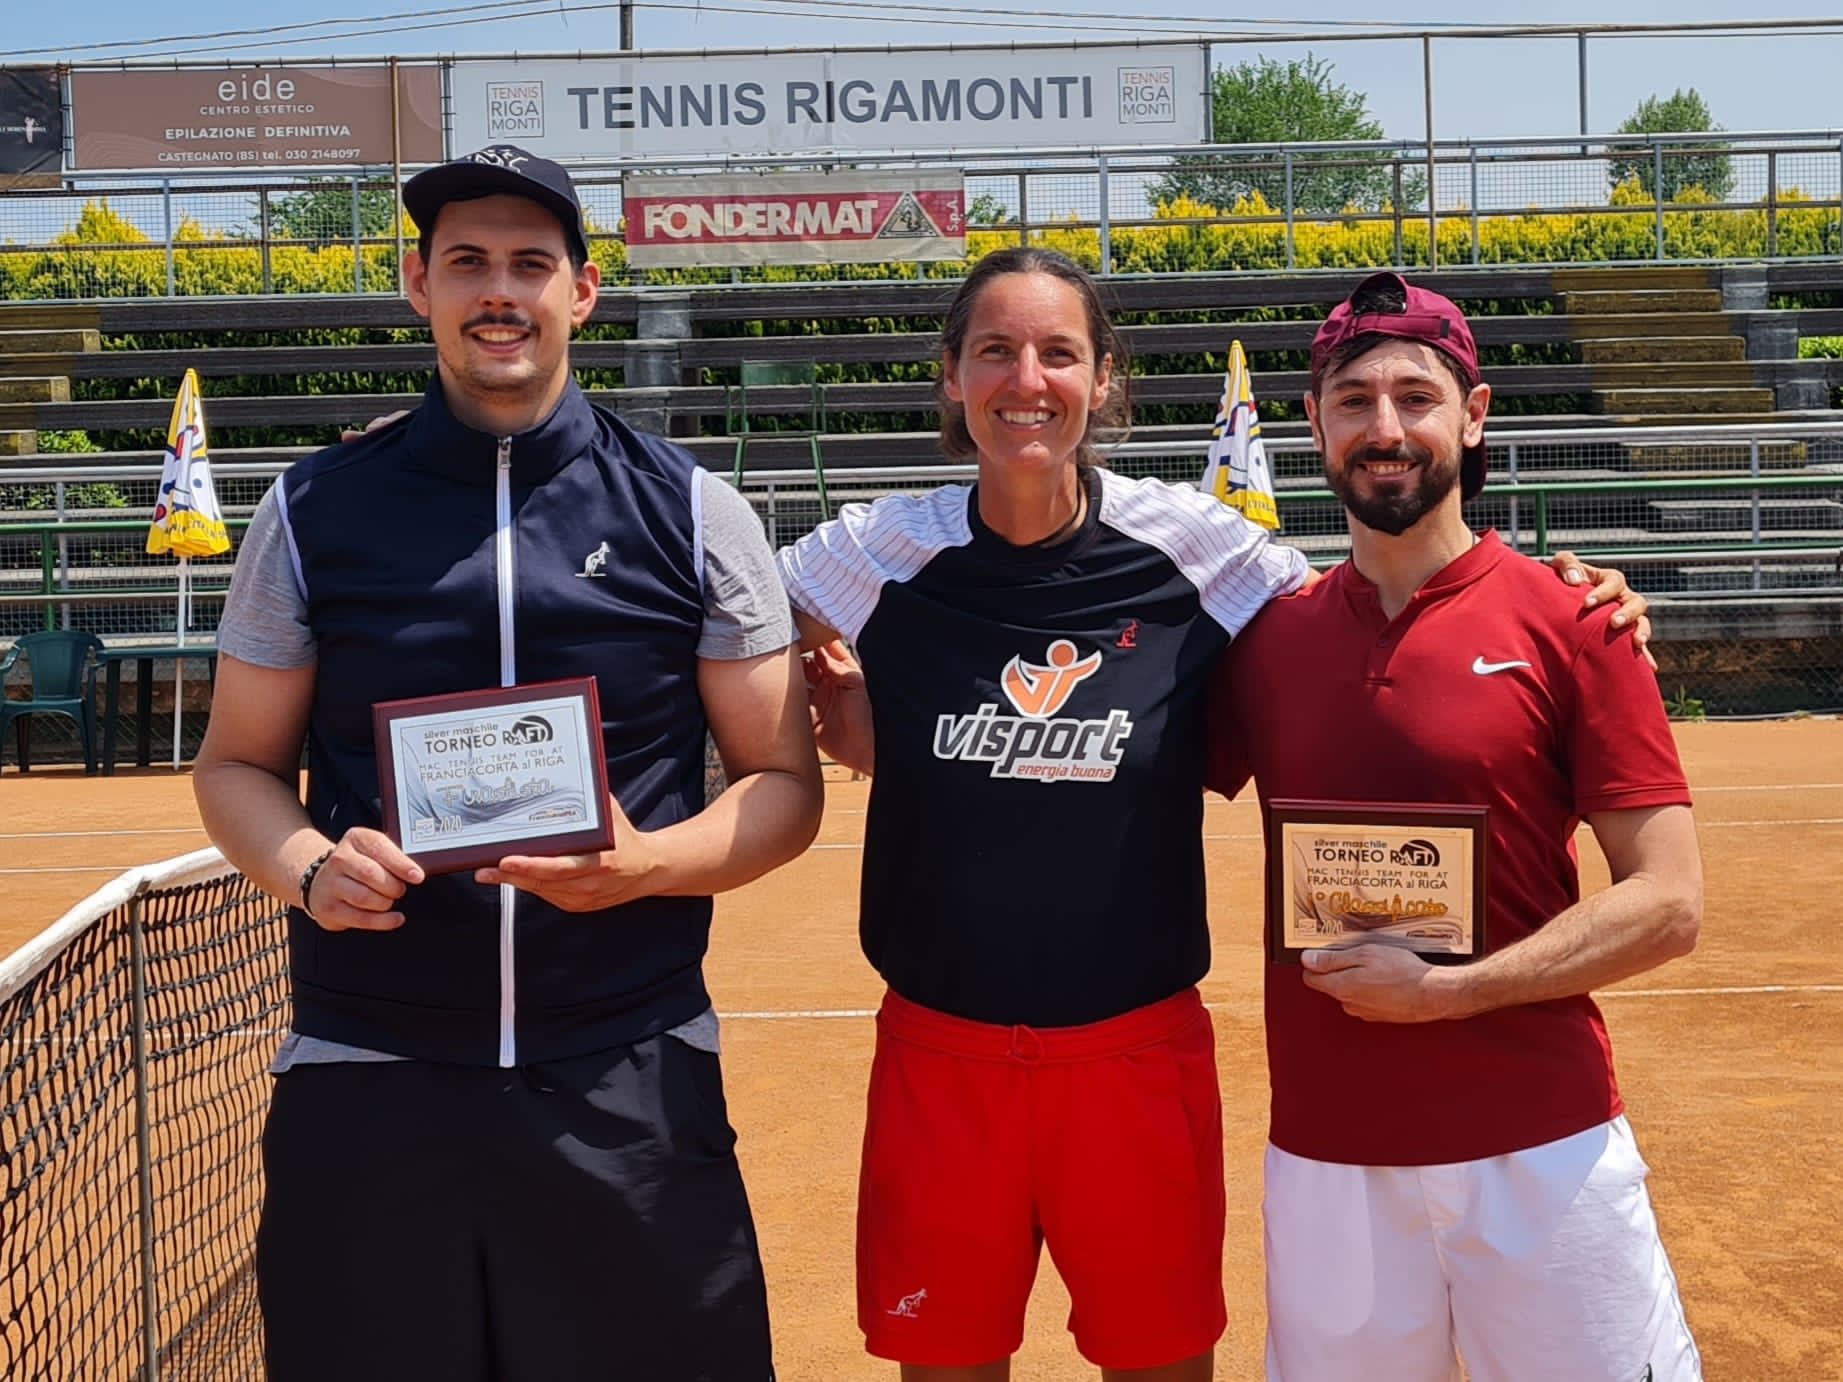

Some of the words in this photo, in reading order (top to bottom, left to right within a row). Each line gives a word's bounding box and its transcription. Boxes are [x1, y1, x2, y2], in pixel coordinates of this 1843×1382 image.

[1122, 71, 1170, 85] TENNIS
[217, 73, 296, 101] eide
[490, 87, 539, 100] TENNIS
[1122, 85, 1171, 102] RIGA
[199, 105, 250, 116] CENTRO
[255, 104, 315, 115] ESTETICO
[490, 100, 540, 117] RIGA
[567, 84, 767, 130] TENNIS
[785, 75, 1093, 124] RIGAMONTI
[1122, 102, 1172, 116] MONTI
[491, 117, 541, 131] MONTI
[165, 127, 256, 140] EPILAZIONE
[264, 125, 351, 138] DEFINITIVA
[157, 151, 234, 162] CASTEGNATO
[236, 151, 260, 162] (BS)
[263, 150, 282, 161] tel.
[285, 150, 308, 160] 030
[311, 148, 361, 160] 2148097
[643, 199, 879, 239] FONDERMAT
[423, 730, 450, 740] silver
[452, 722, 499, 735] maschile
[424, 733, 497, 755] TORNEO
[936, 705, 1130, 775] visport
[419, 761, 441, 771] MAC
[448, 756, 484, 768] TENNIS
[491, 751, 517, 762] TEAM
[525, 749, 544, 758] FOR
[552, 745, 564, 754] AT
[420, 761, 519, 782] FRANCIACORTA
[534, 754, 566, 768] RIGA
[1016, 764, 1068, 780] energia
[1070, 766, 1114, 779] buona
[1314, 838, 1340, 848] silver
[1342, 840, 1388, 849] maschile
[1314, 848, 1385, 863] TORNEO
[1307, 868, 1328, 876] MAC
[1335, 868, 1369, 877] TENNIS
[1376, 869, 1402, 877] TEAM
[1410, 871, 1429, 879] FOR
[1437, 871, 1448, 879] AT
[1307, 875, 1402, 889] FRANCIACORTA
[1418, 879, 1449, 890] RIGA
